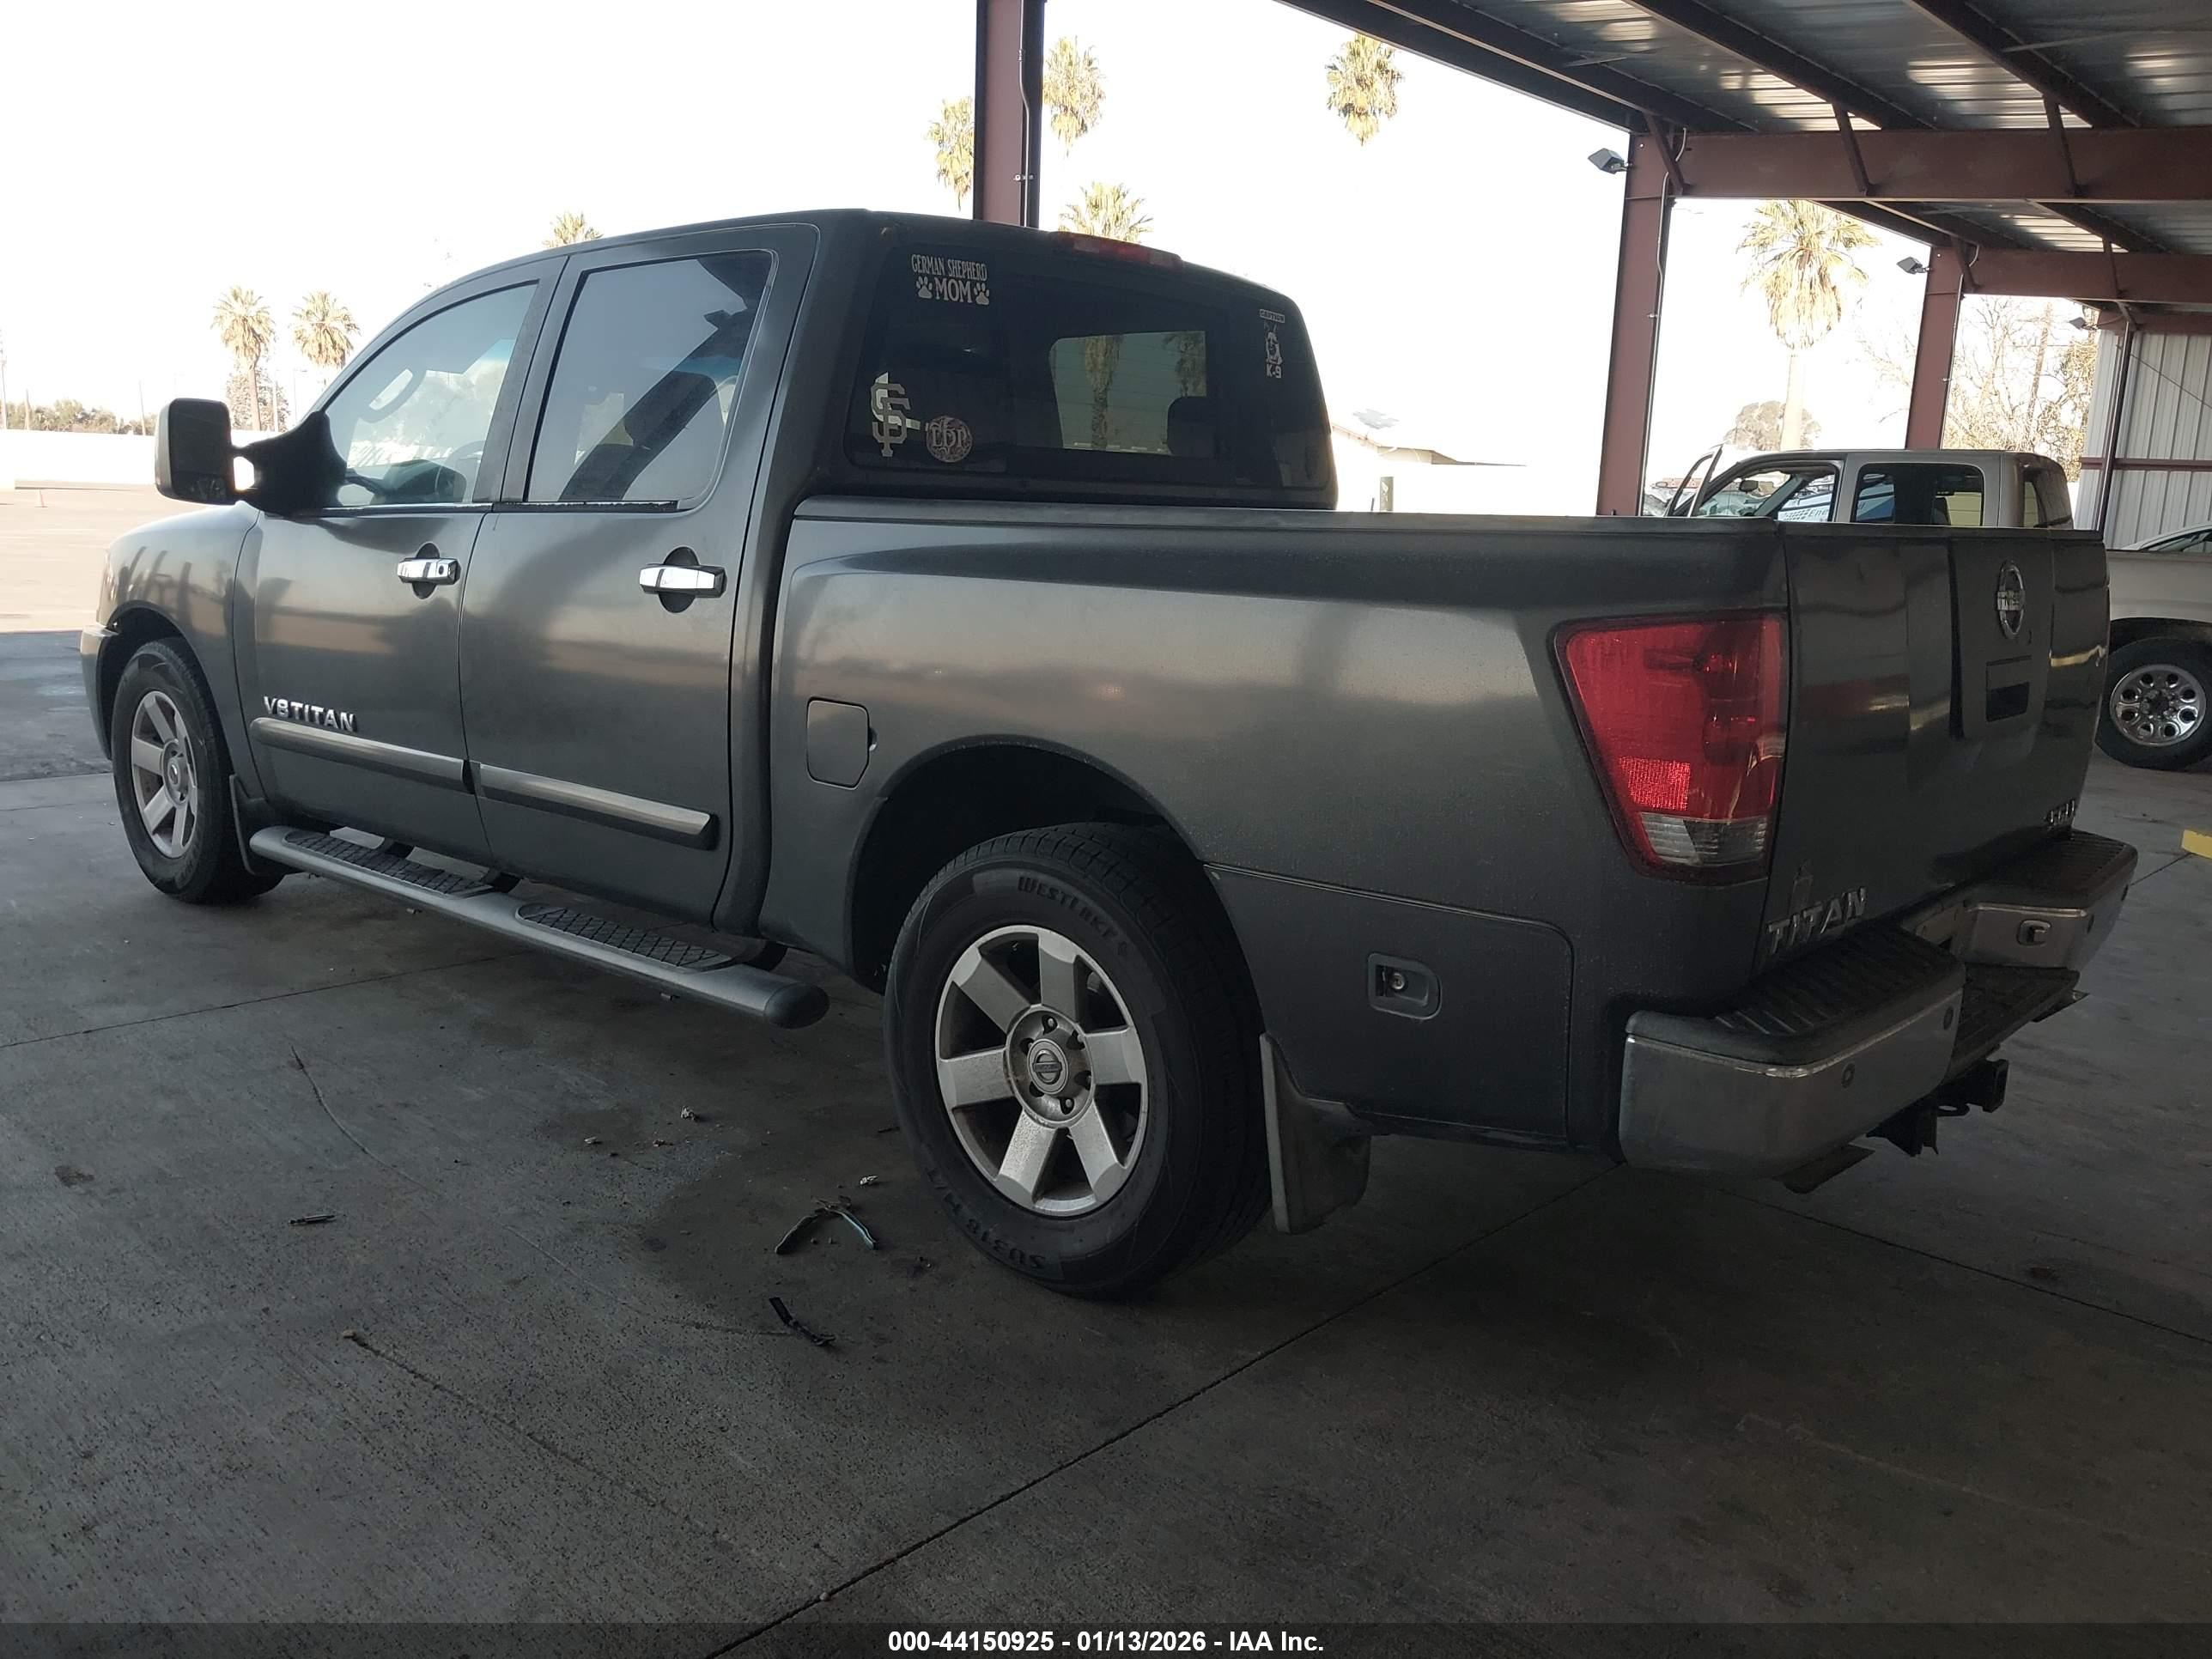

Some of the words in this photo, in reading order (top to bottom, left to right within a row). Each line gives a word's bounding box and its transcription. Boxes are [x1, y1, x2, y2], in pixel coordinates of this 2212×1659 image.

[911, 254, 945, 276] GERMAN
[947, 258, 988, 282] SHEPHERD
[933, 276, 974, 303] MOM
[1266, 363, 1282, 379] K-9
[1768, 886, 1868, 955] TITAN
